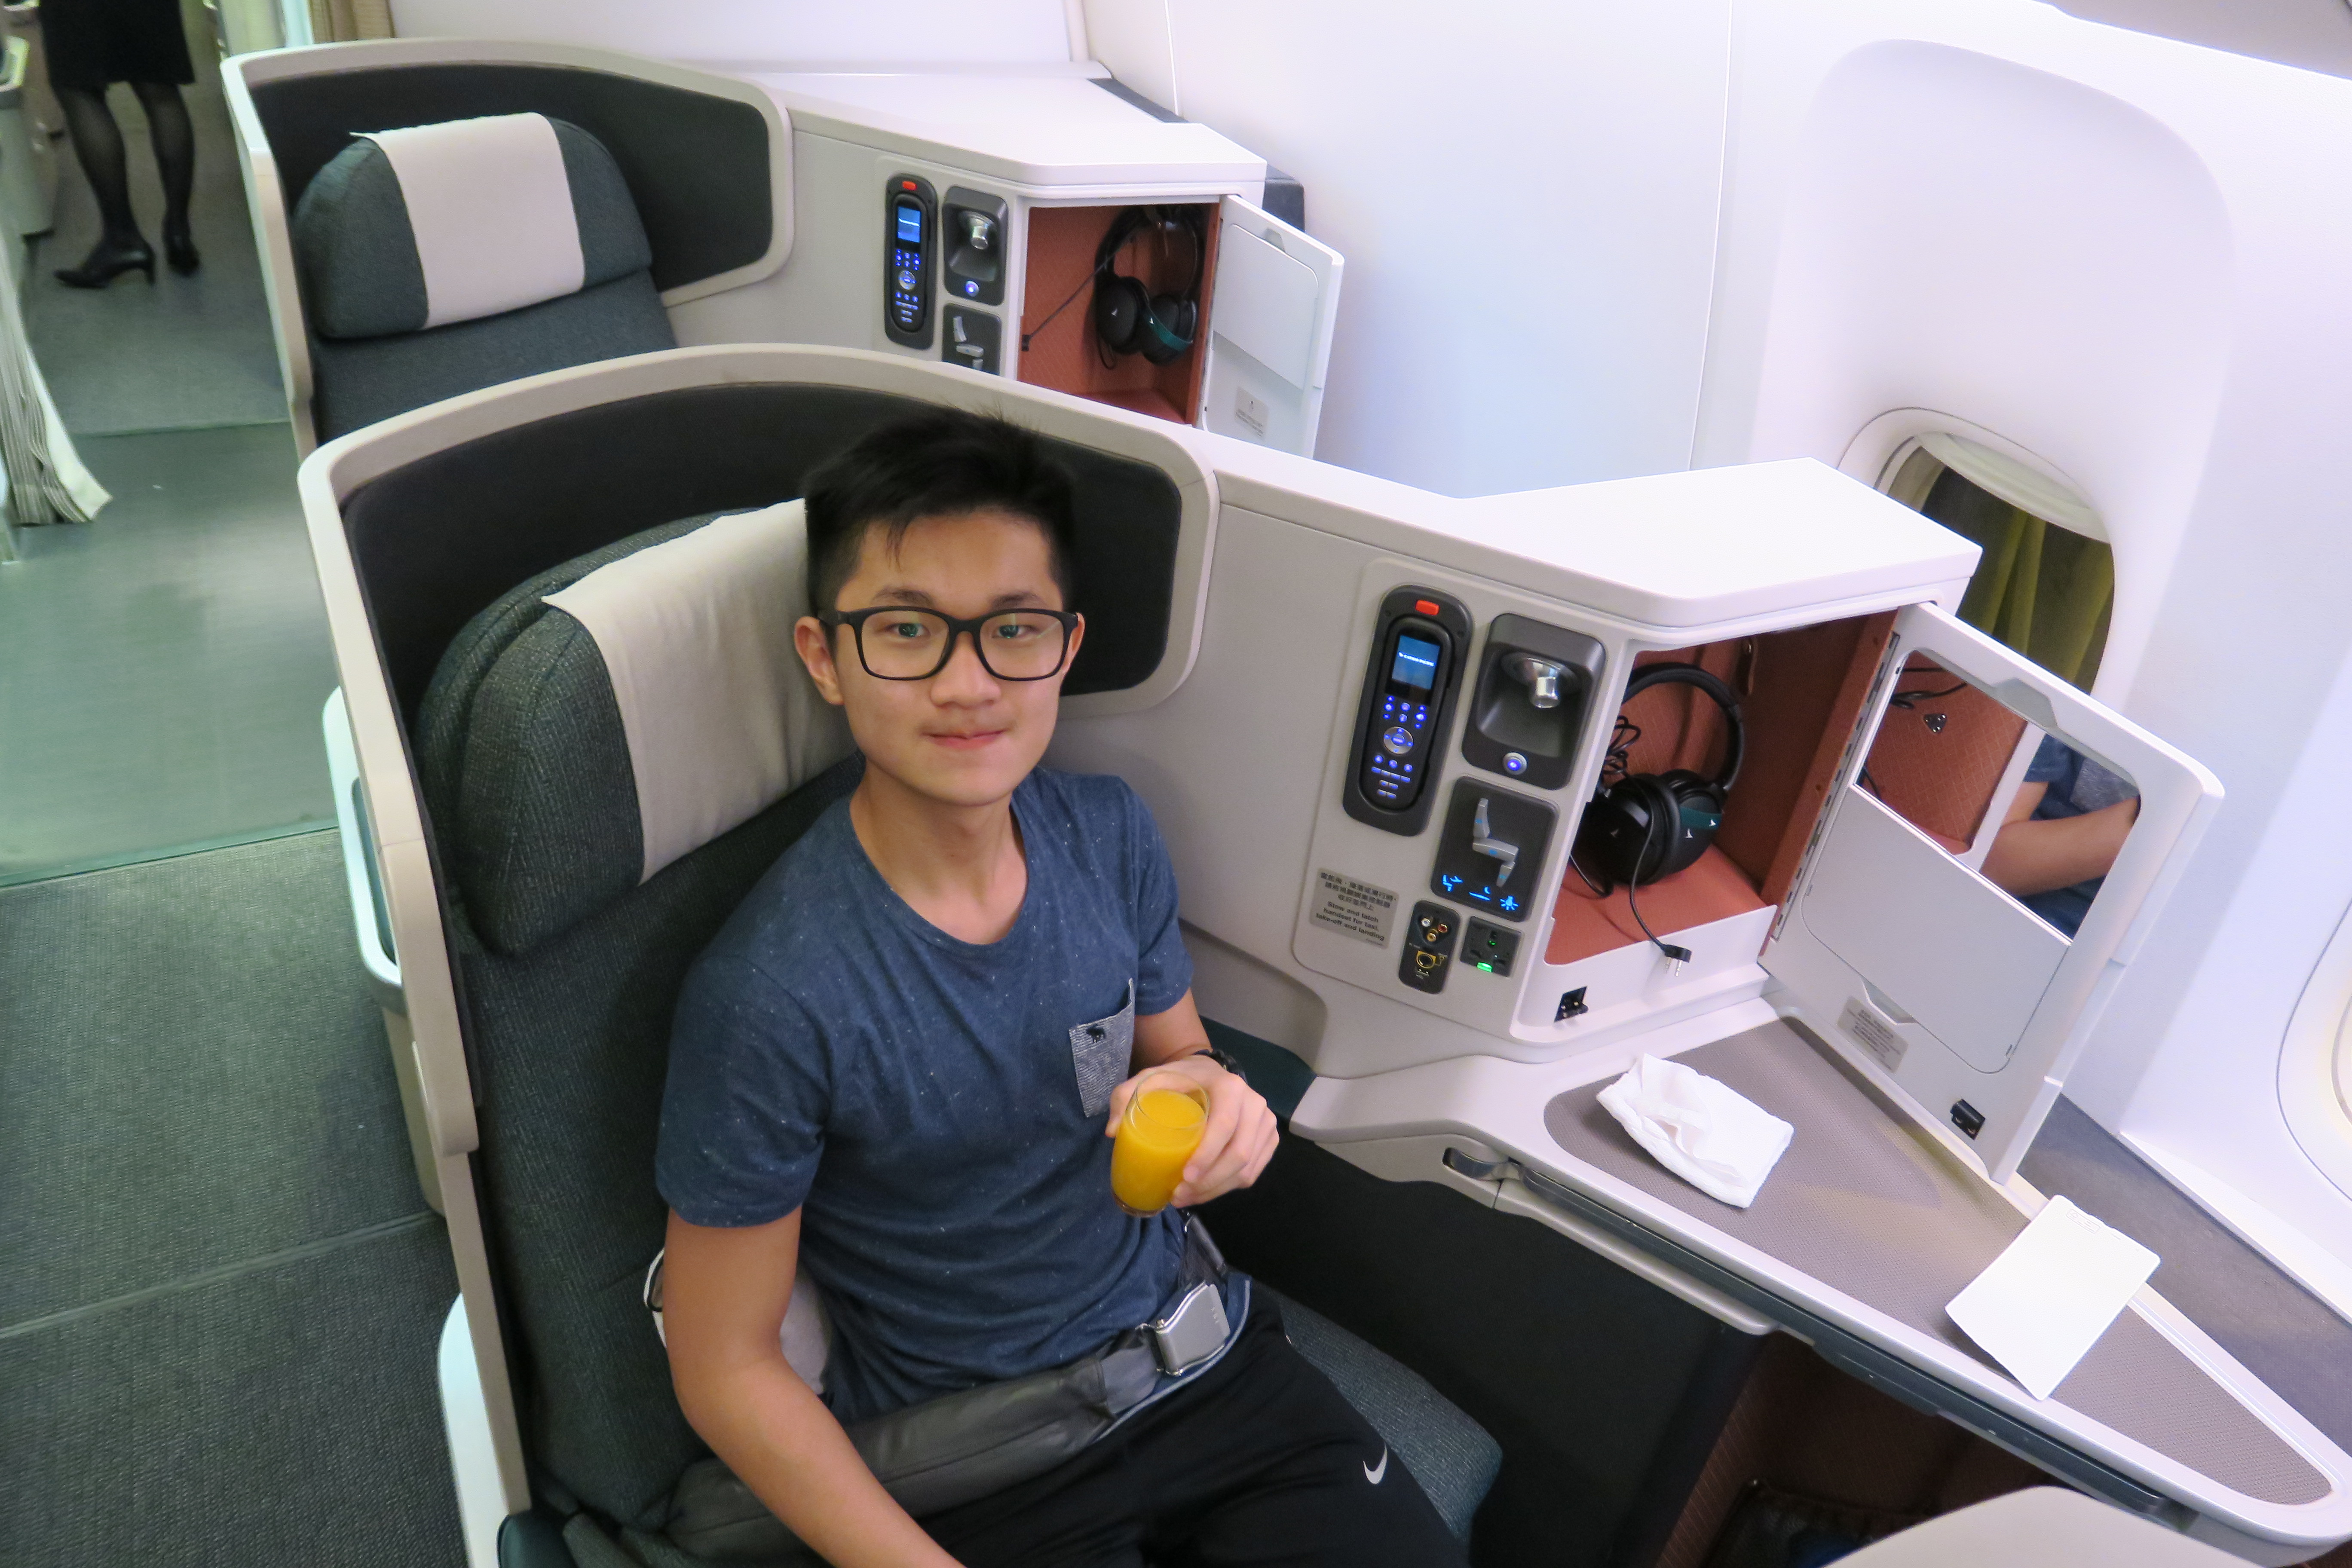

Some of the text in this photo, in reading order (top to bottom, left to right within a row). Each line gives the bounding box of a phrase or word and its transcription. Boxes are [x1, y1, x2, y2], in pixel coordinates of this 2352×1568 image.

[1323, 907, 1351, 922] handset
[1327, 901, 1345, 911] Stow
[1361, 913, 1379, 923] latch
[1316, 913, 1342, 925] take-off
[1358, 927, 1384, 941] landing
